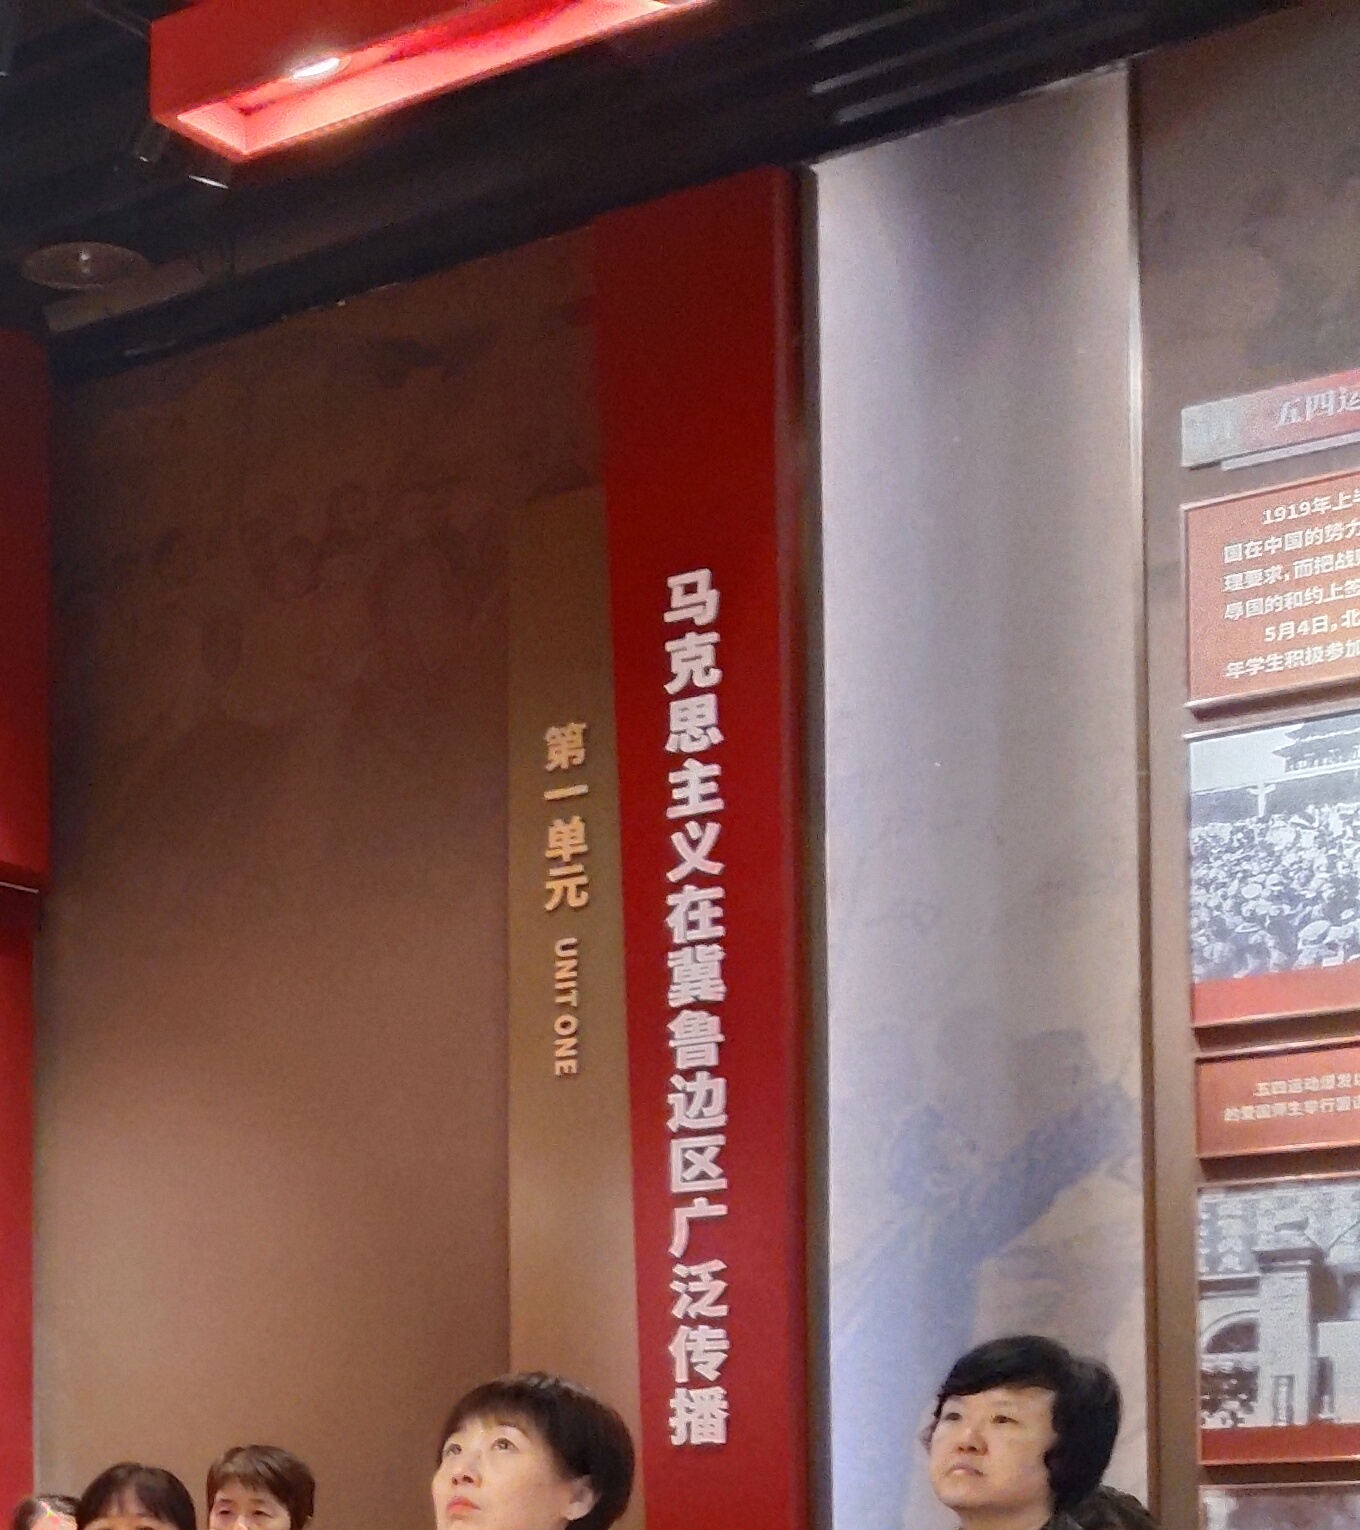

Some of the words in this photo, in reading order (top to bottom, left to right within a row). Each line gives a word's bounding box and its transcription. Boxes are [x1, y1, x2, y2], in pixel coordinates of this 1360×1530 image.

[1223, 548, 1360, 592] 理要求，而把战
[543, 721, 589, 912] 第一单元
[554, 937, 578, 1007] UNIT
[664, 567, 730, 1447] 马克思主义在冀鲁边区广泛传播
[554, 1014, 578, 1077] ONE
